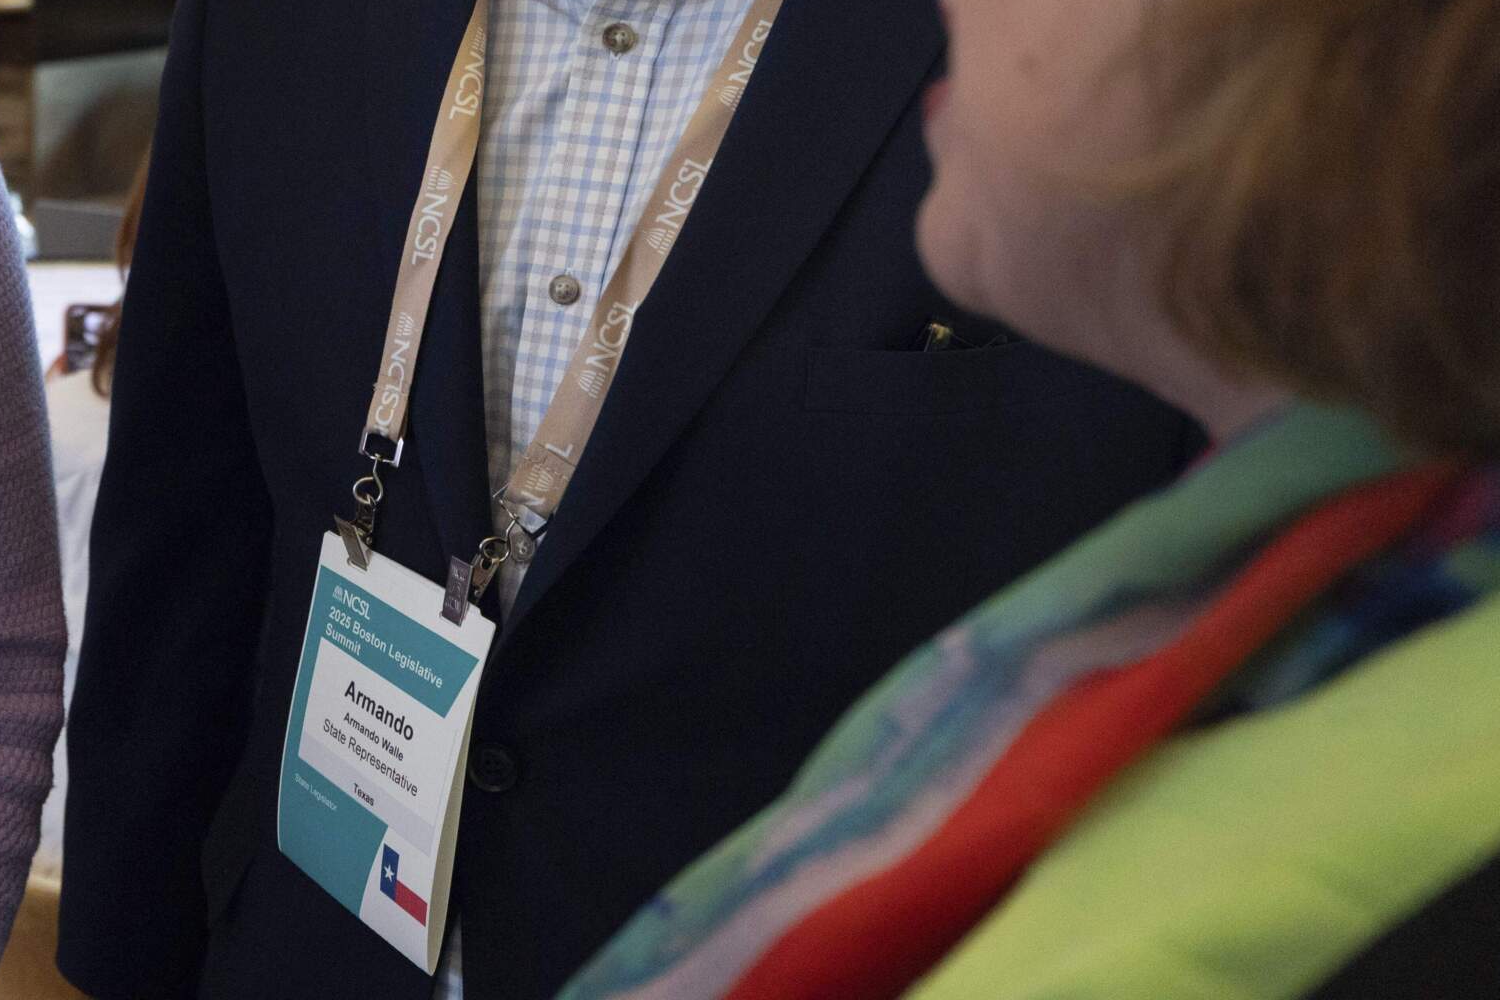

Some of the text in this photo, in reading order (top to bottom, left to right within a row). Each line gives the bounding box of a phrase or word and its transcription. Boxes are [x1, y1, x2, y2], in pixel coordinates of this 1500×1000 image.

[449, 51, 485, 120] NCSL
[655, 158, 713, 229] NCSL
[411, 193, 448, 265] NCSL
[585, 301, 639, 372] NCSL
[325, 622, 362, 656] Summit
[342, 589, 371, 620] NCSL
[328, 606, 443, 689] 2025 Boston Legislative
[343, 712, 404, 761] Armando Walle
[344, 680, 414, 741] Armando
[323, 718, 418, 797] State Representative
[353, 782, 375, 806] Texas
